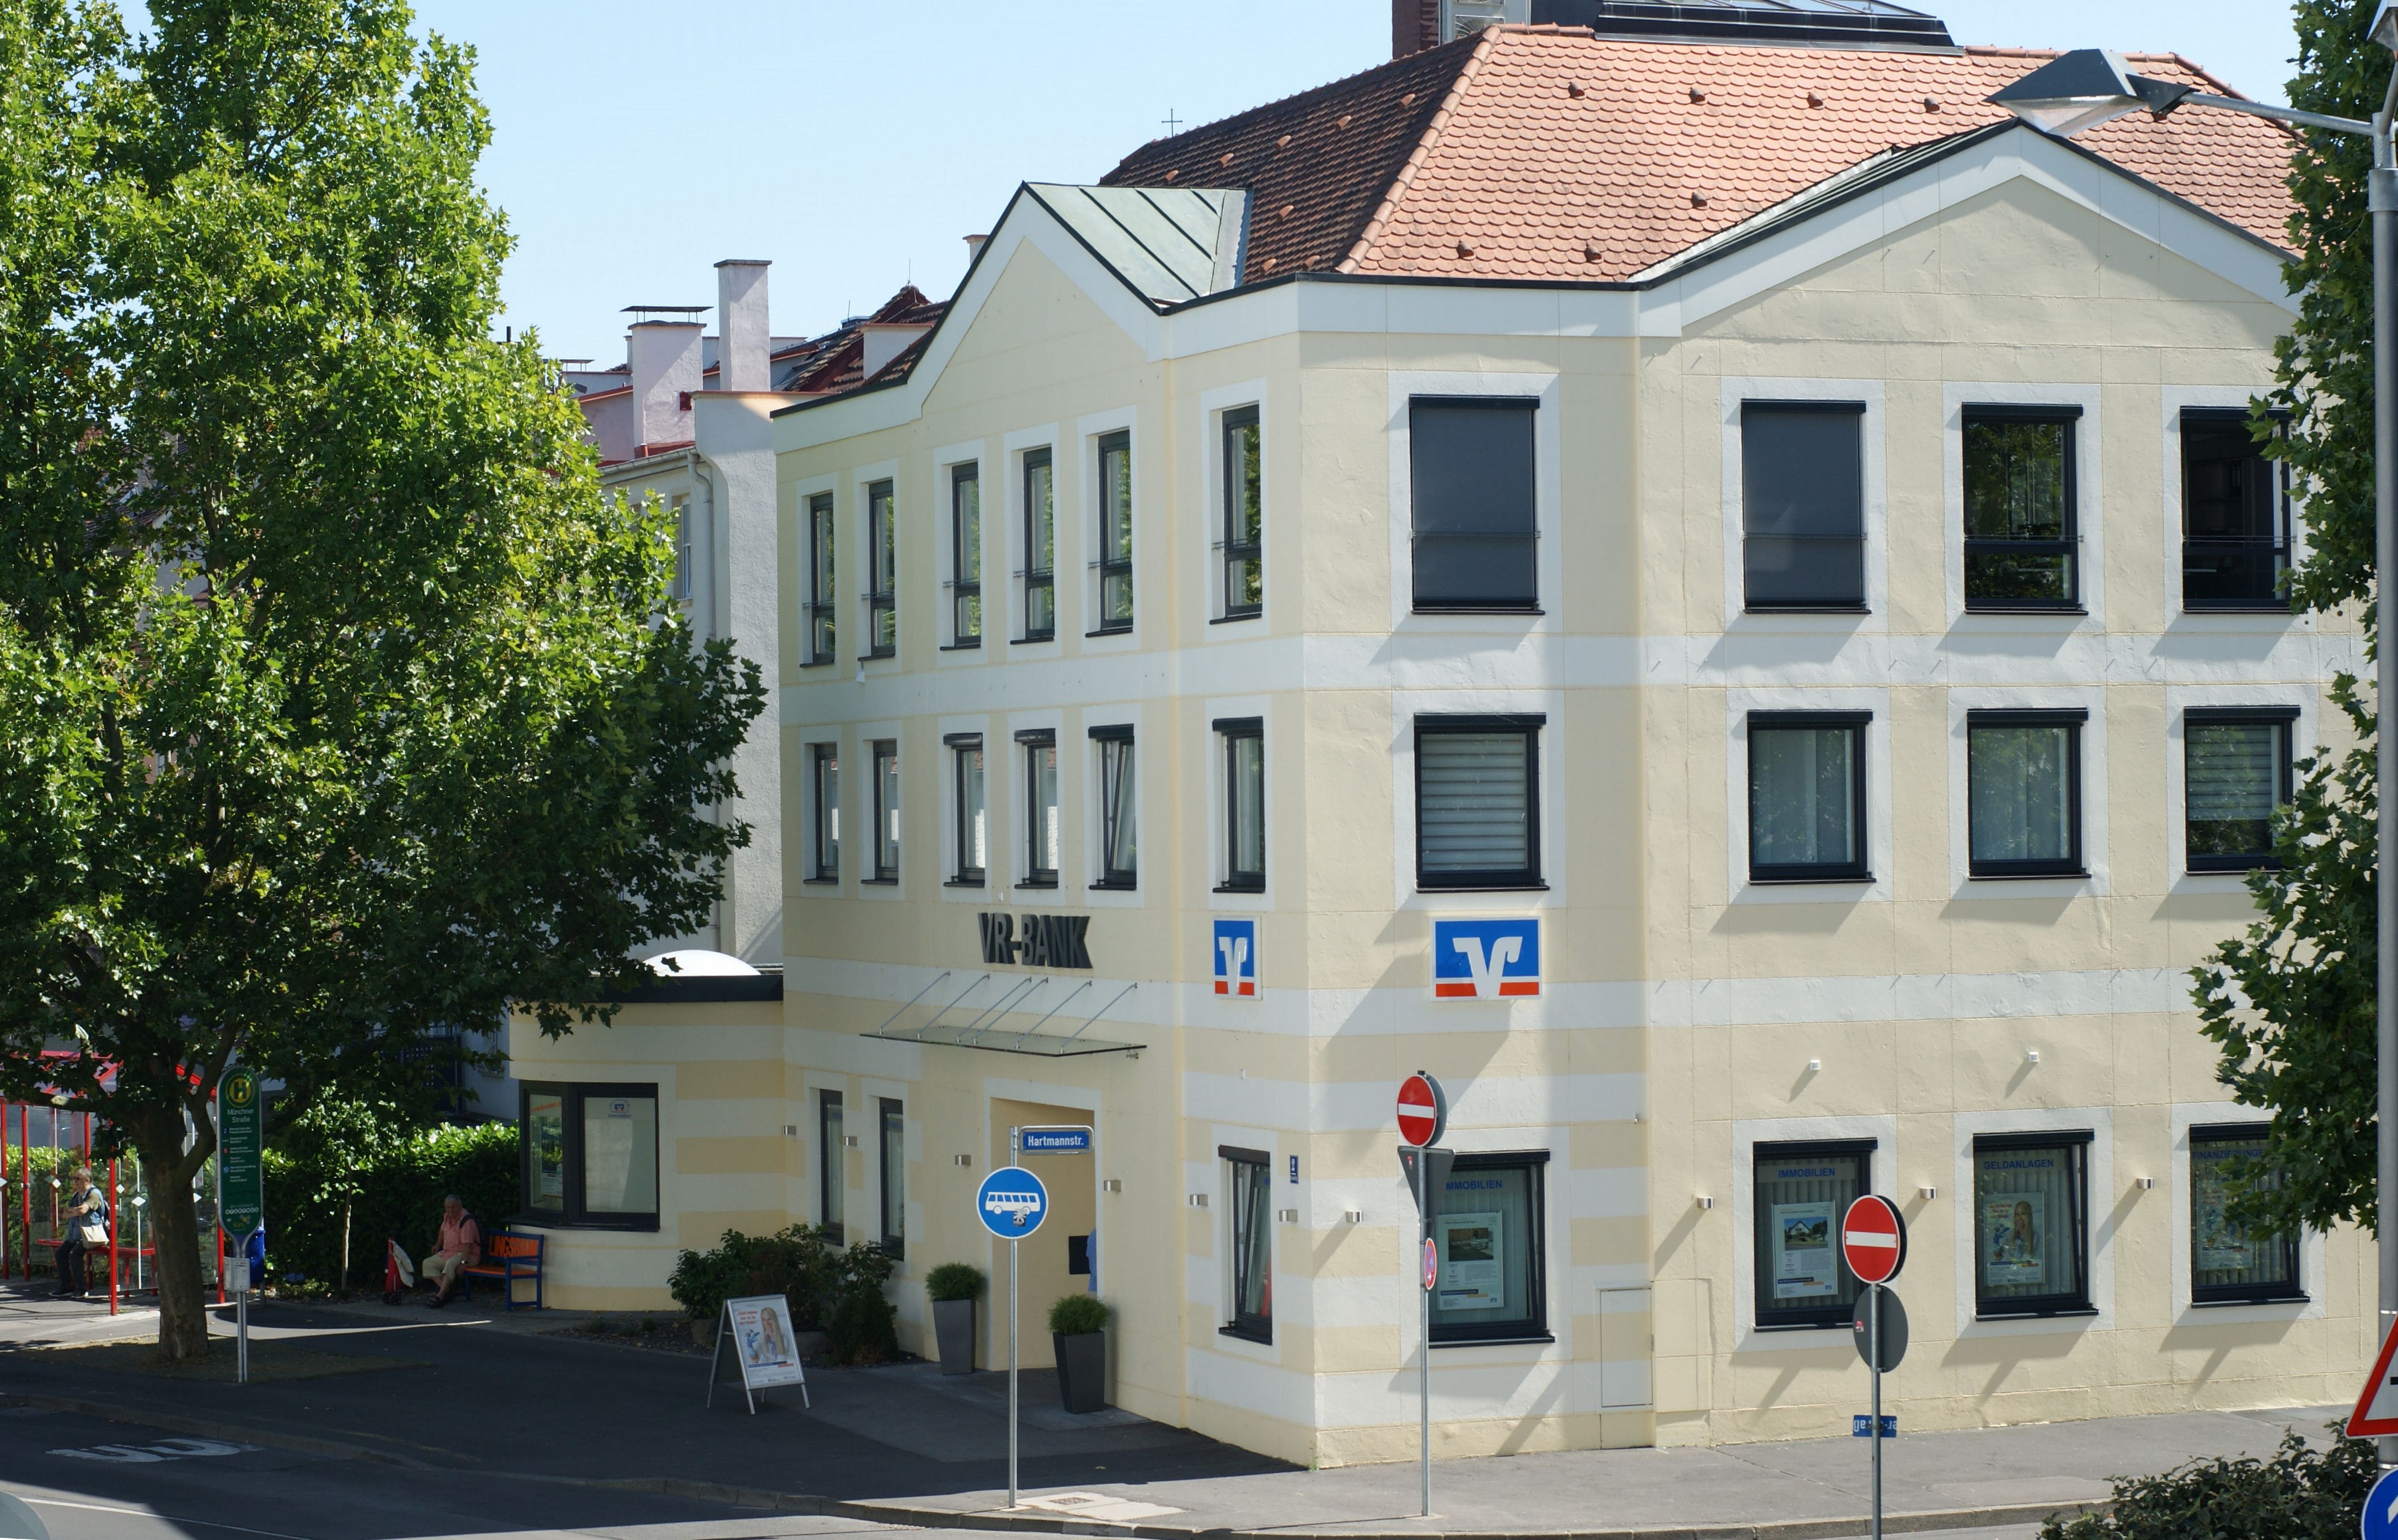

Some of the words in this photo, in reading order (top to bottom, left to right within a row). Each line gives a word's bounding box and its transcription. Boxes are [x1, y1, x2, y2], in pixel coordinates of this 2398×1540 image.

[978, 913, 1093, 968] VR-BANK
[234, 1082, 247, 1098] H
[1028, 1135, 1084, 1146] Hartmannstr.
[1984, 1160, 2054, 1170] GELDANLAGEN
[1778, 1168, 1836, 1178] IMMOBILIEN
[1446, 1180, 1502, 1190] MMOBILIEN
